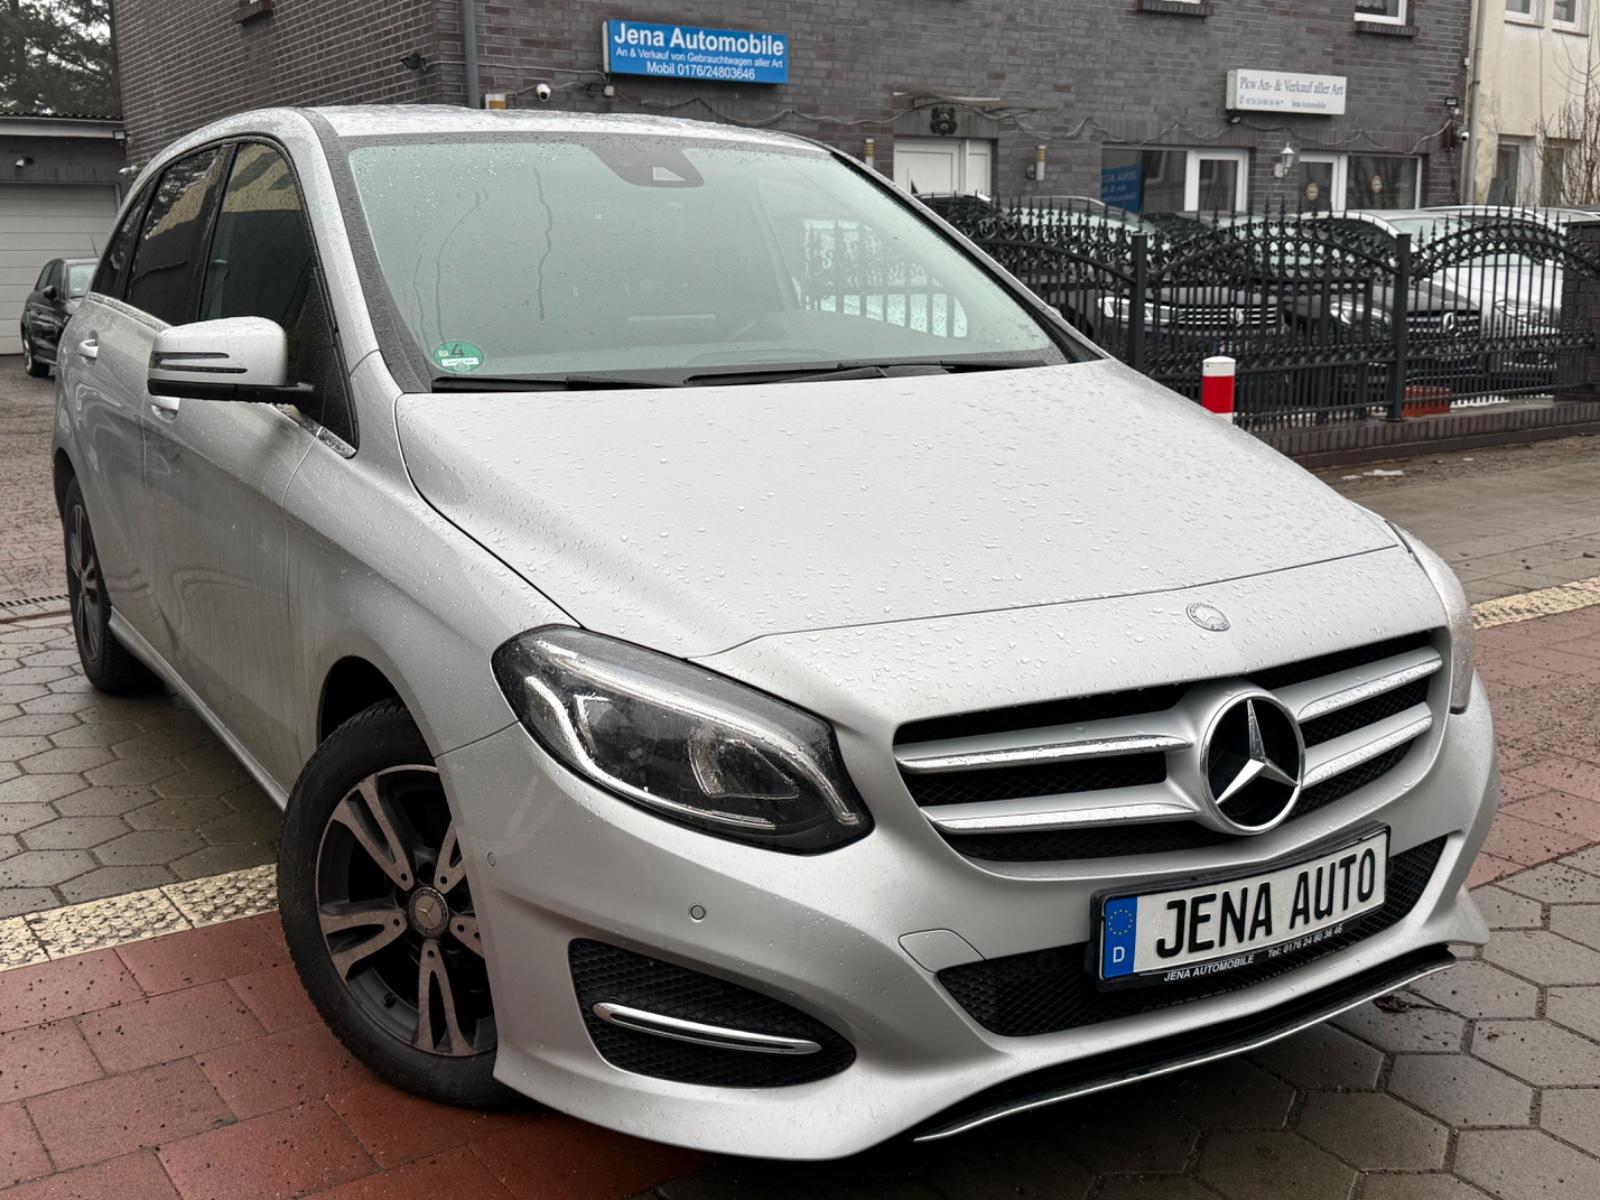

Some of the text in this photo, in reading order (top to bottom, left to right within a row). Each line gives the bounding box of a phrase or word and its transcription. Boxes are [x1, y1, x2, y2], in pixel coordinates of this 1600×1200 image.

[614, 22, 784, 56] Jena Automobile
[616, 46, 783, 69] An & Verkauf von Gebrauchtwagen aller Art
[646, 60, 756, 80] Mobil 0176/24803646
[1240, 76, 1256, 90] Pkw
[1274, 79, 1281, 91] &
[1284, 79, 1313, 94] Verkauf
[1313, 82, 1330, 94] aller
[1330, 84, 1344, 96] Art
[451, 343, 465, 357] 4
[1155, 847, 1376, 959] JENA AUTO
[1112, 946, 1125, 963] D
[1163, 969, 1190, 982] JENA
[1192, 954, 1255, 977] AUTOMOBILE
